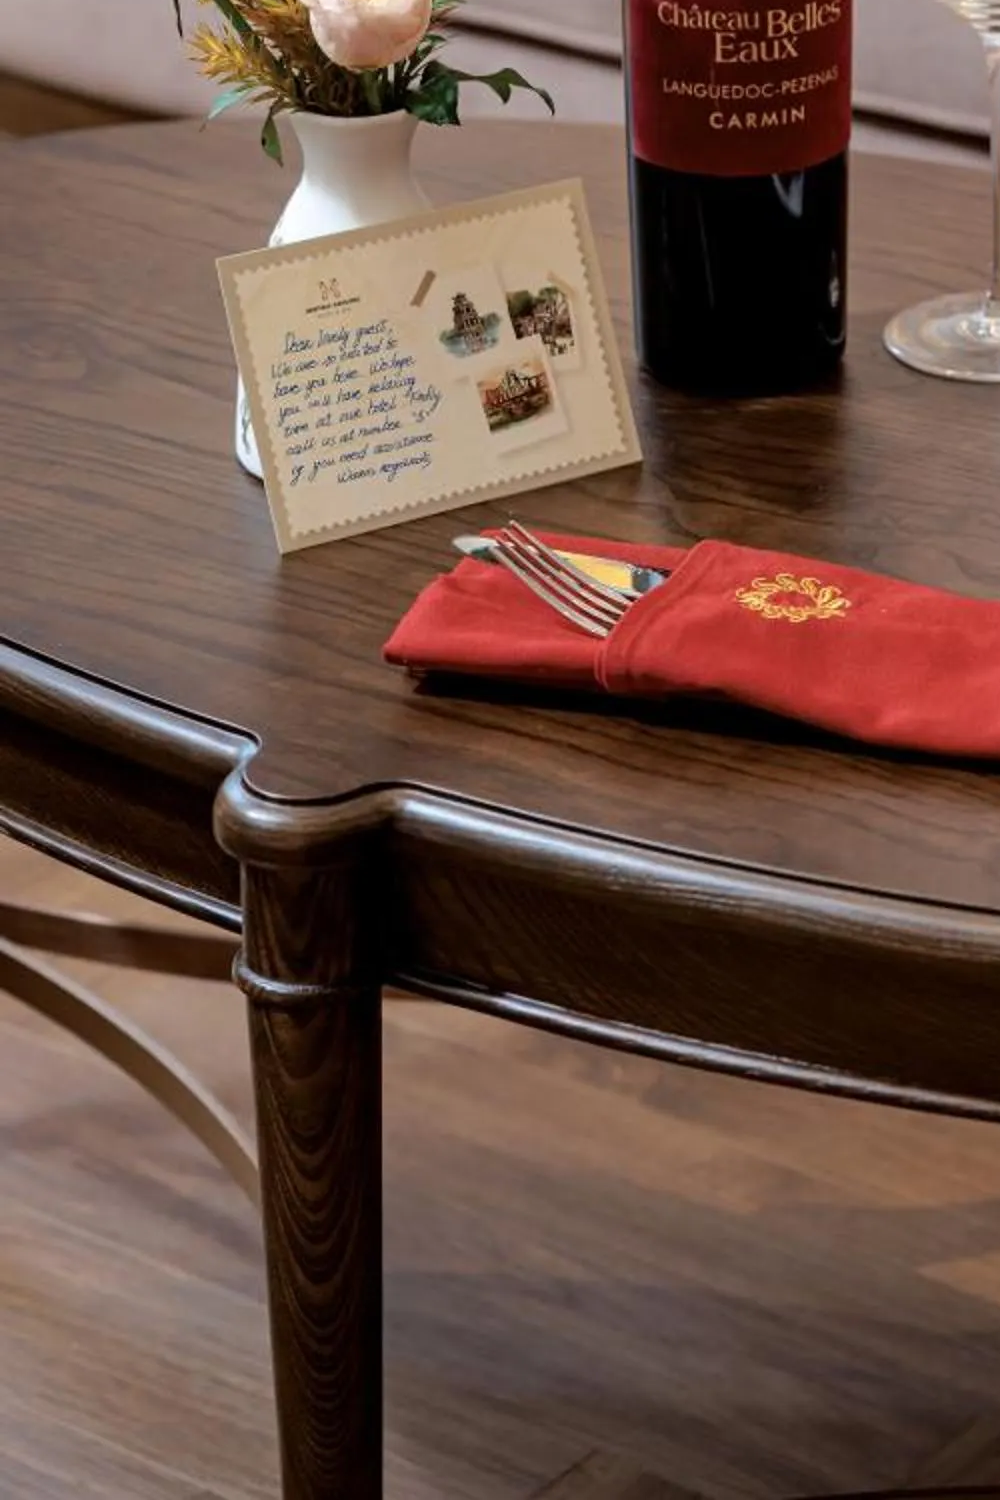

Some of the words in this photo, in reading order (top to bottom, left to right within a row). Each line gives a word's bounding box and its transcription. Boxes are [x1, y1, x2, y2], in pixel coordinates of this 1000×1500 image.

[657, 1, 760, 30] Château
[715, 31, 799, 63] Eaux
[709, 105, 806, 130] CARMIN
[284, 331, 313, 355] Dear
[304, 378, 326, 400] you
[278, 406, 300, 427] you
[336, 388, 361, 404] have
[316, 412, 331, 428] at
[308, 459, 336, 482] you
[339, 442, 369, 462] need
